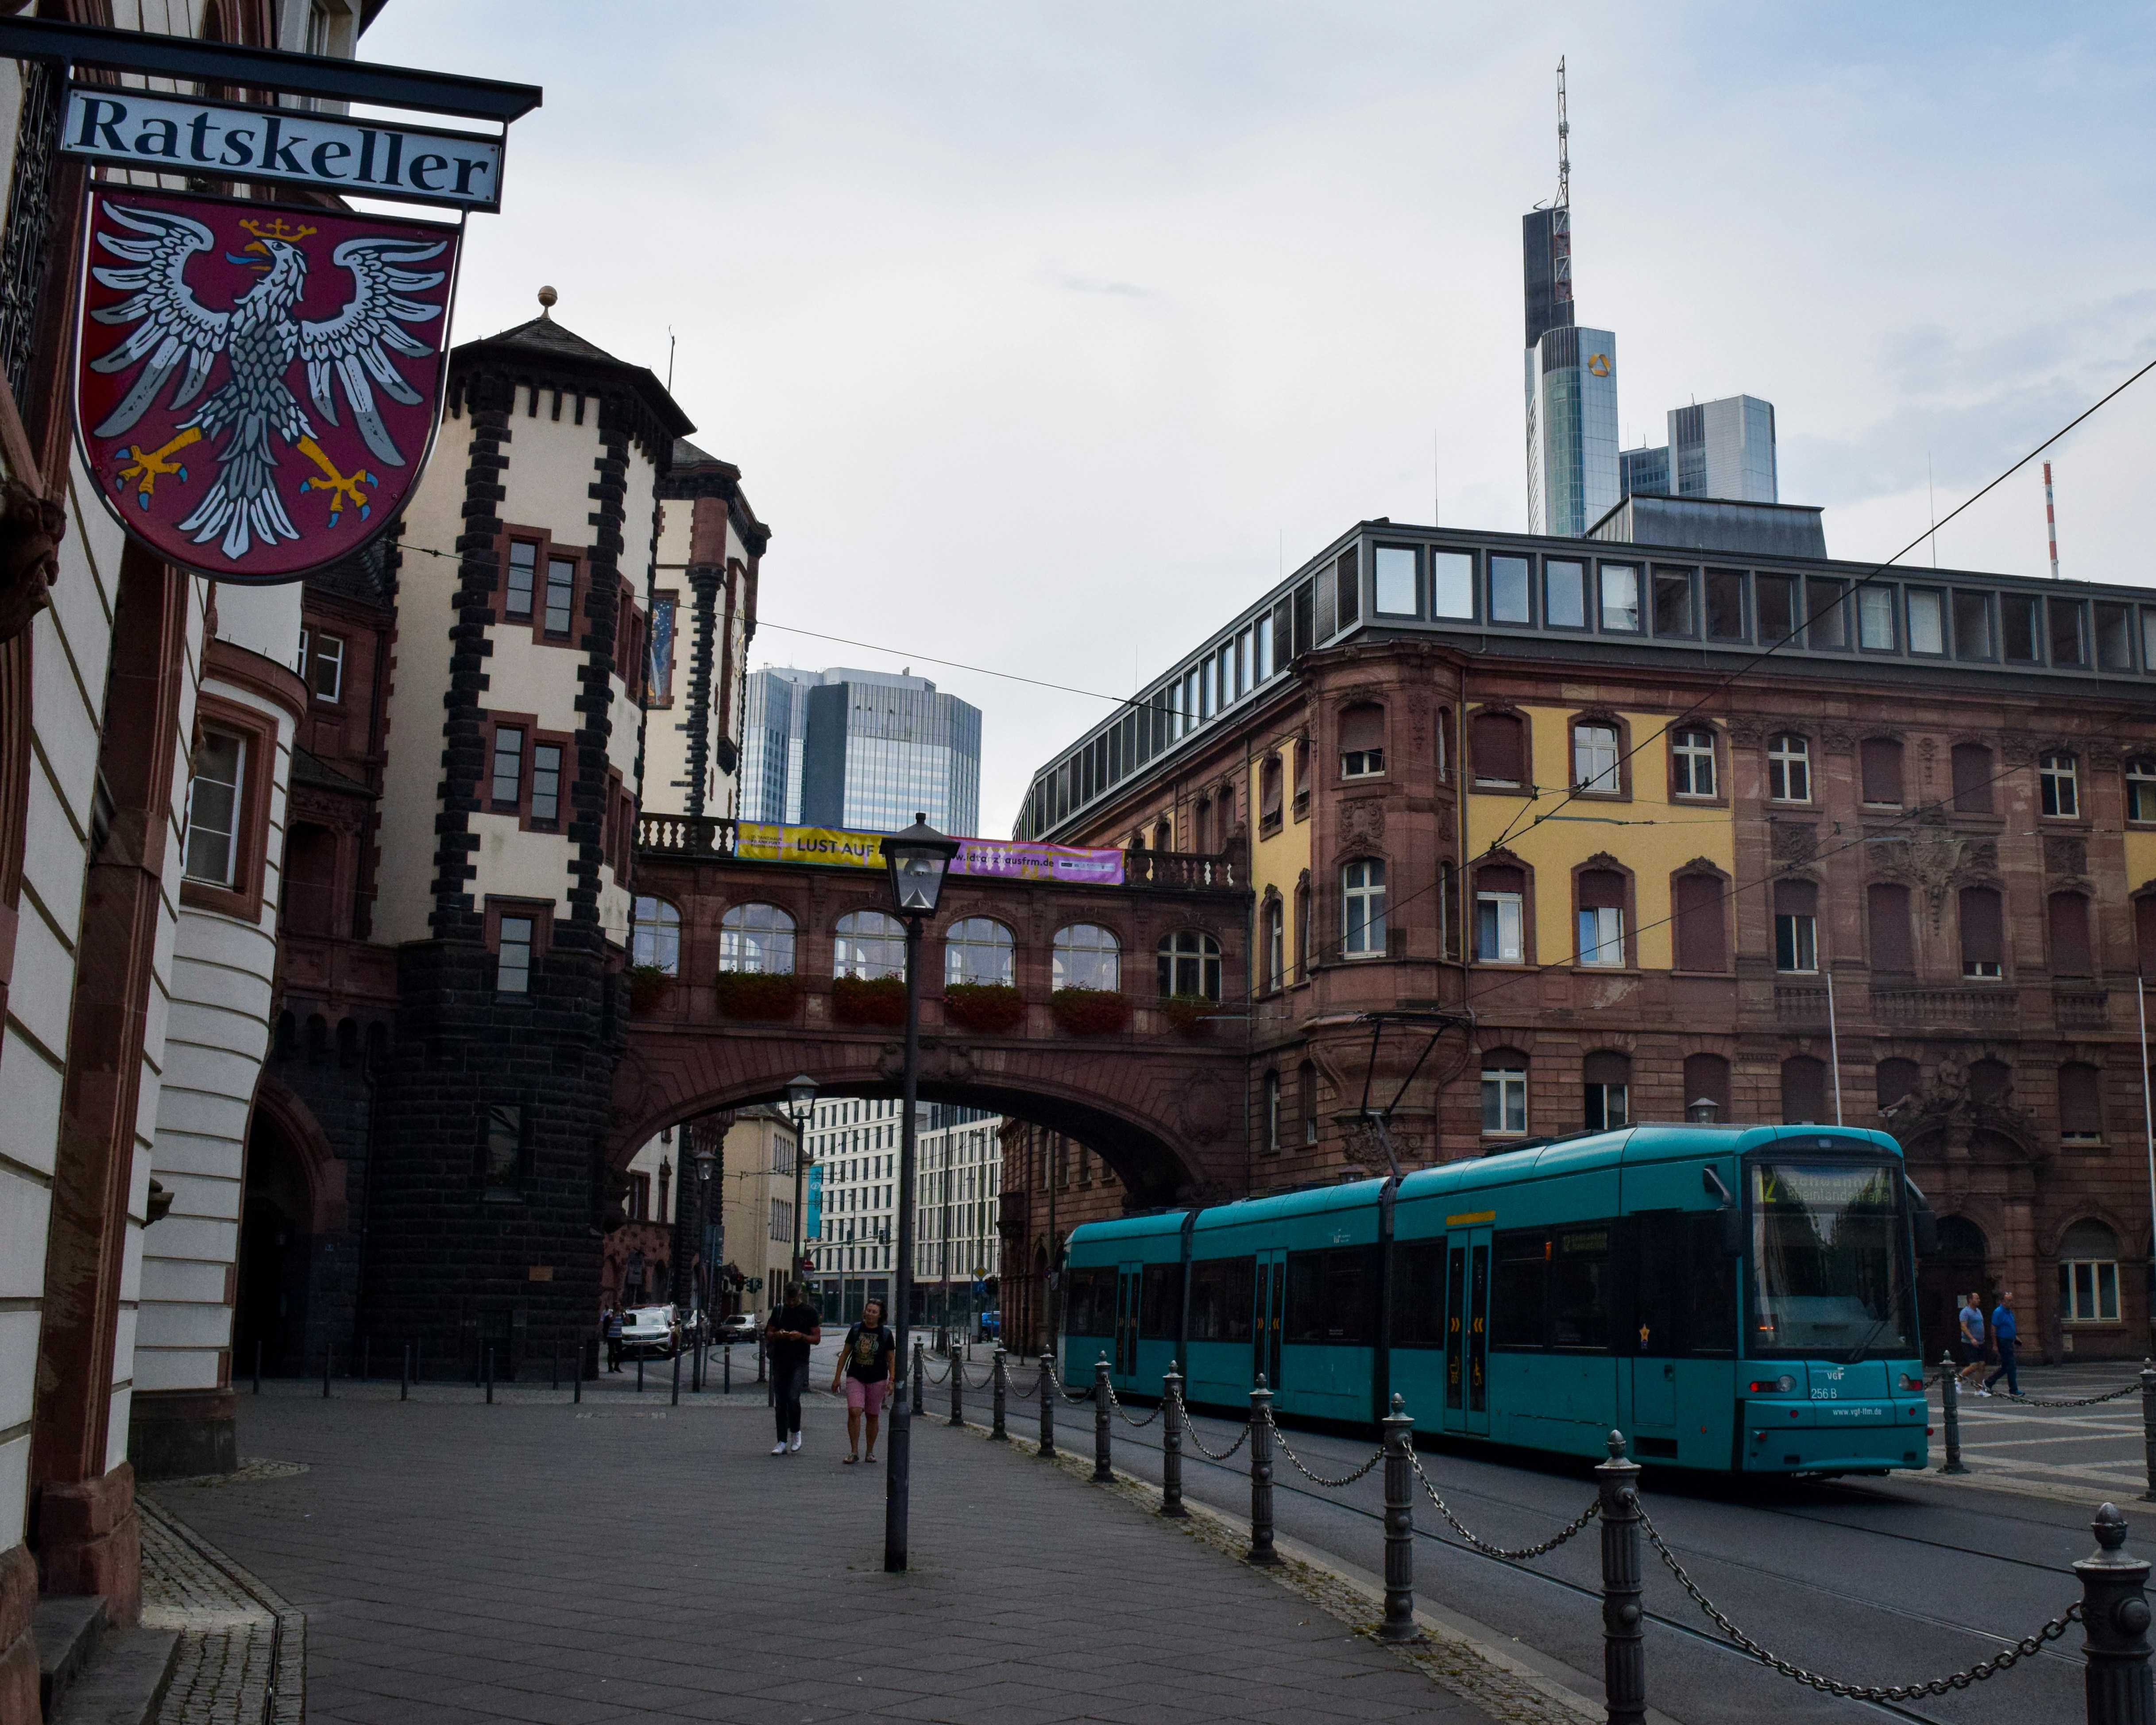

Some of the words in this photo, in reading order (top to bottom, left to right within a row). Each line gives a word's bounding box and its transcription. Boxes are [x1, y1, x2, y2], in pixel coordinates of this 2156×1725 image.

[74, 97, 488, 195] Ratskeller
[797, 838, 838, 853] LUST
[842, 843, 874, 857] AUF
[952, 853, 1054, 867] w.idtanzhausfrm.de
[1827, 1367, 1844, 1380] VGF
[1811, 1388, 1828, 1399] 256
[1831, 1388, 1837, 1399] B
